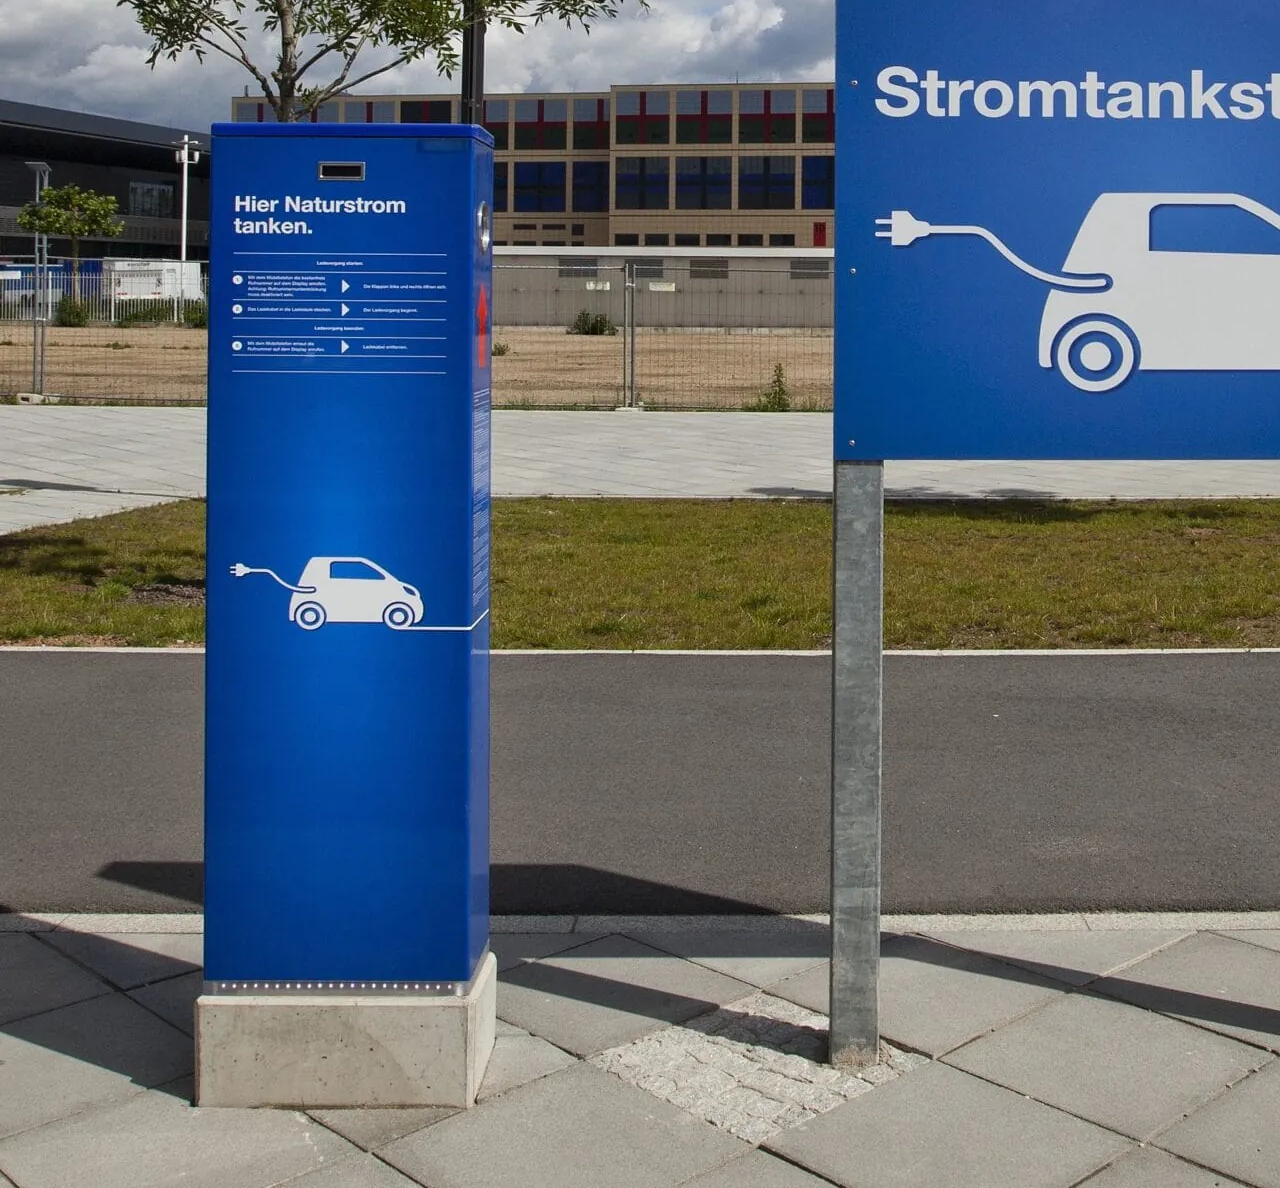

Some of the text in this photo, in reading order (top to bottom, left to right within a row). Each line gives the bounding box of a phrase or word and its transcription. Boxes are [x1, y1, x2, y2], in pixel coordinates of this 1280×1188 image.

[234, 195, 406, 214] Hier Naturstrom
[233, 217, 313, 234] tanken.
